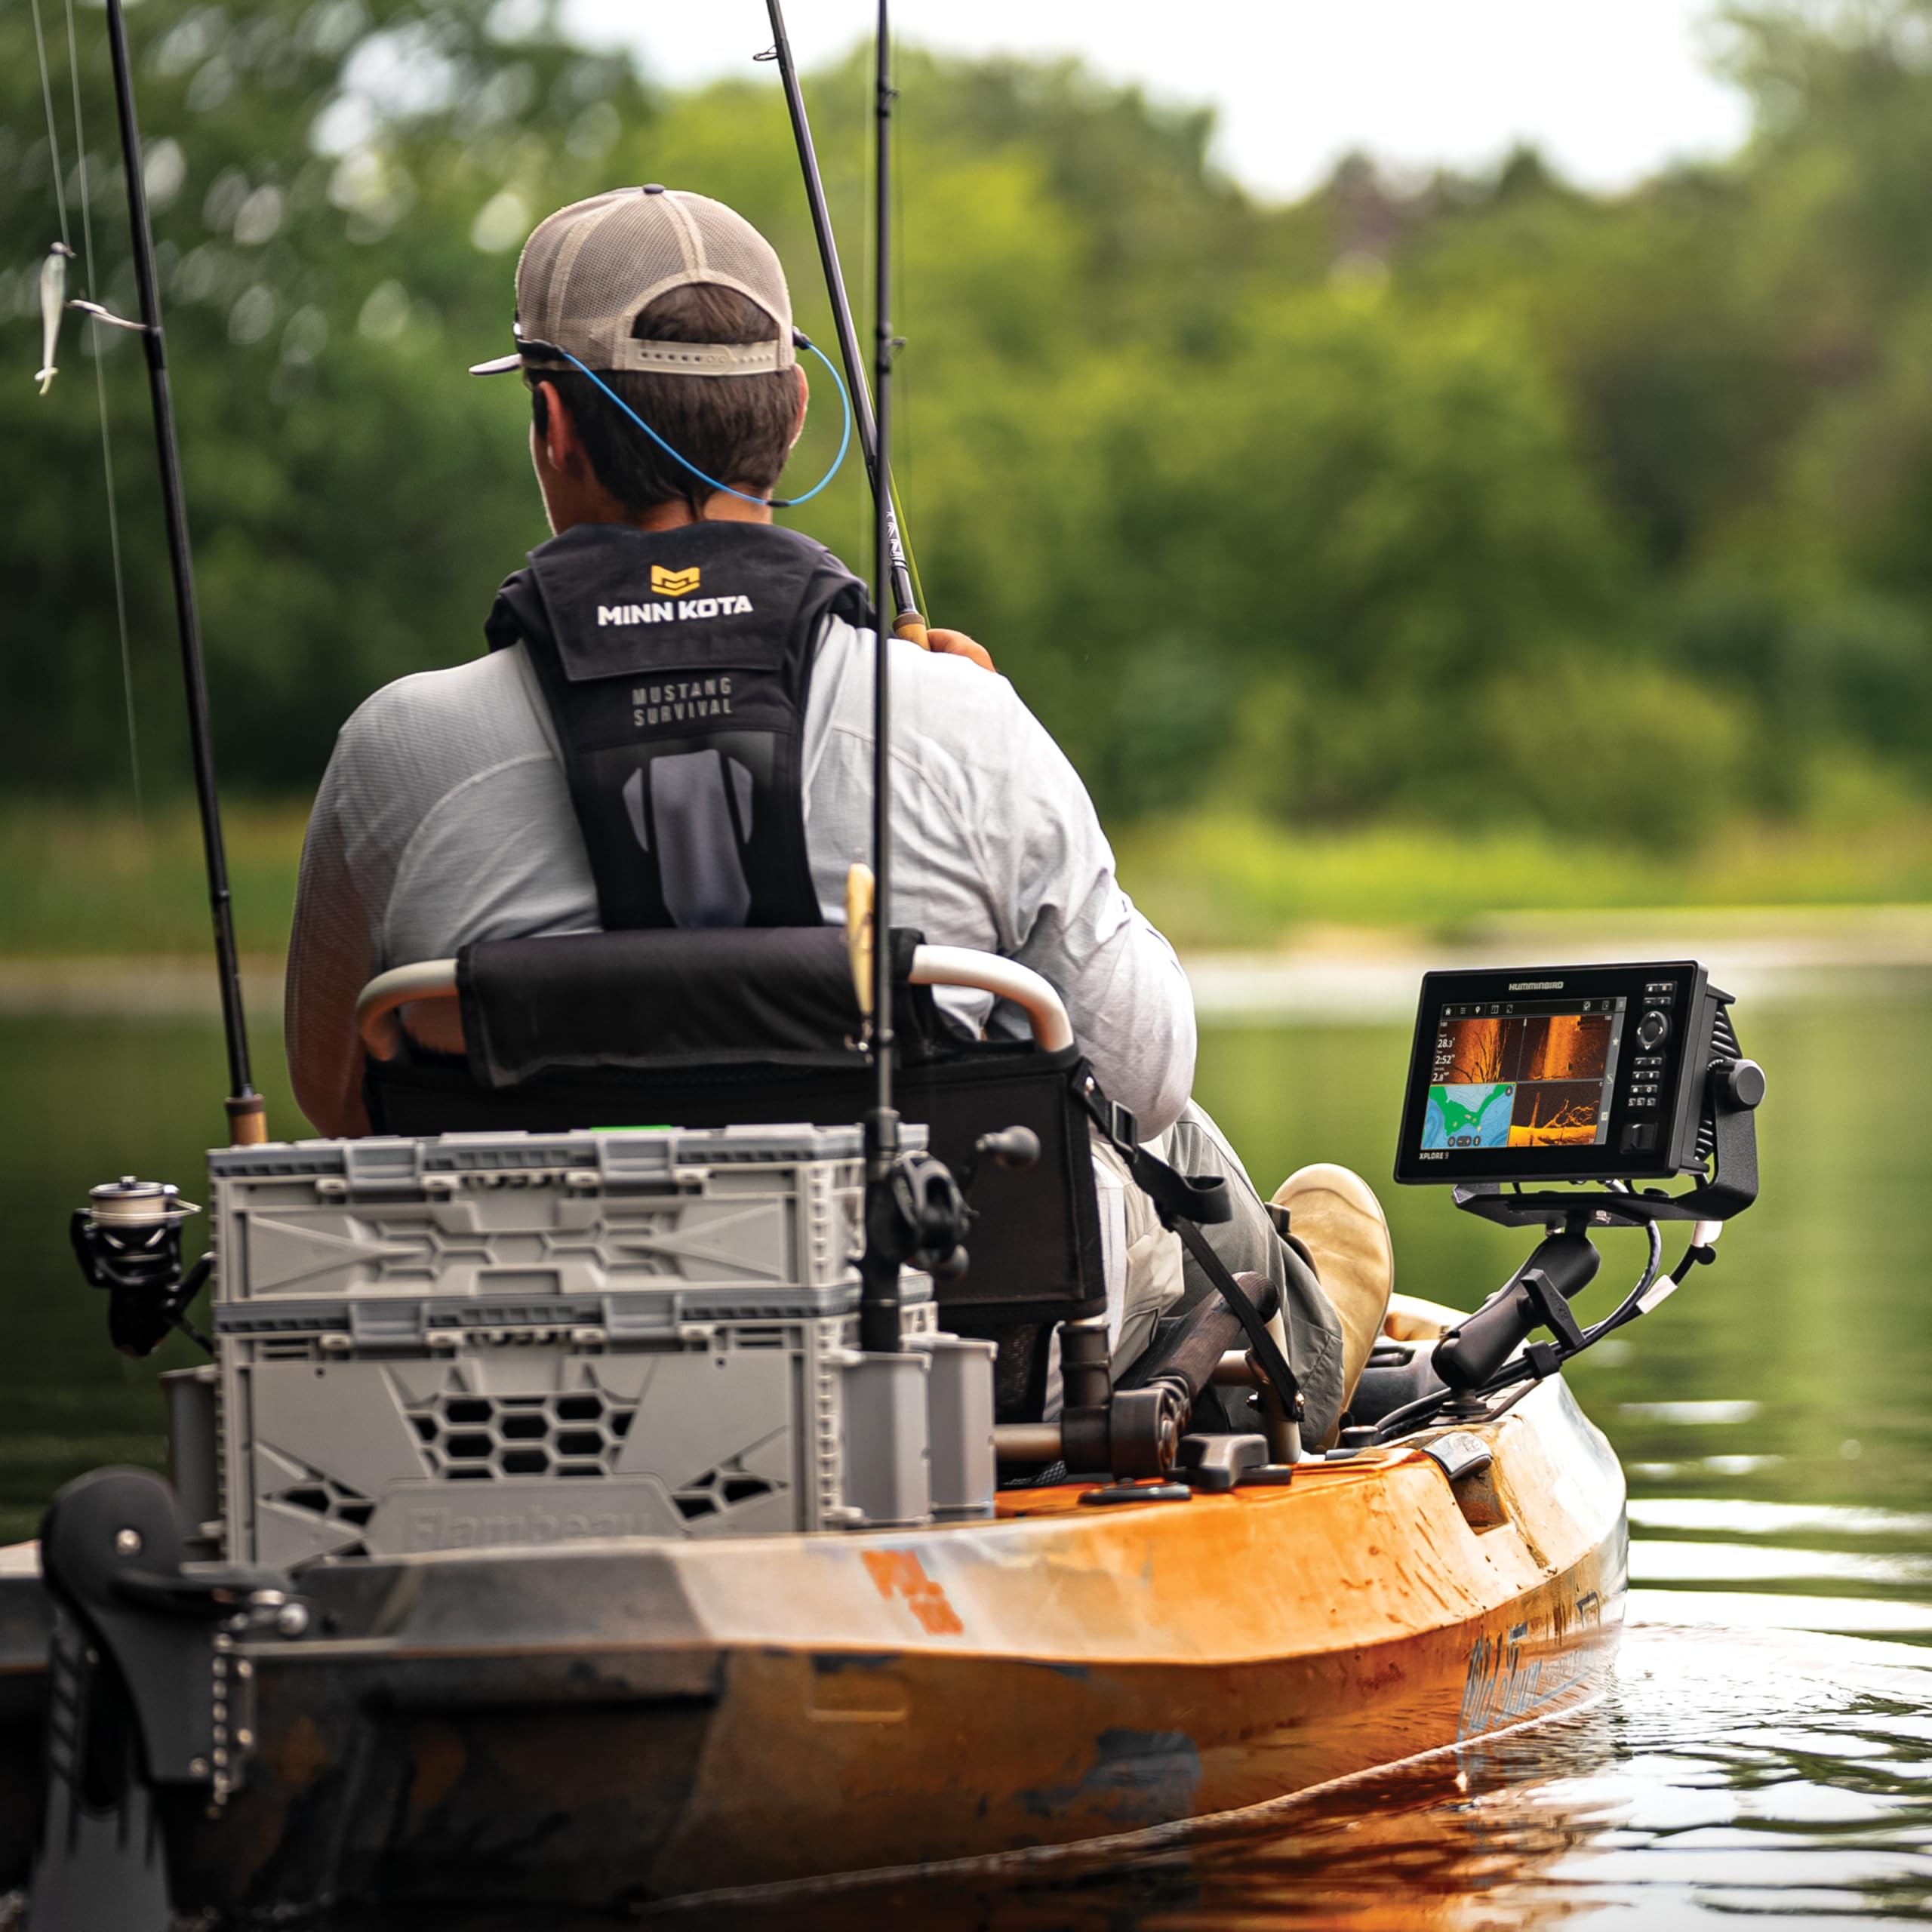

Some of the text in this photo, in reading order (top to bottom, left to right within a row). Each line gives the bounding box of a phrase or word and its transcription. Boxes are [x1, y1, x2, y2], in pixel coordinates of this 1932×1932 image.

[598, 595, 753, 626] MINN KOTA
[632, 678, 732, 706] MUSTANG
[633, 699, 732, 726] SURVIVAL
[1509, 981, 1564, 991] HUMMINBIRD
[1419, 1152, 1444, 1160] XPLORE
